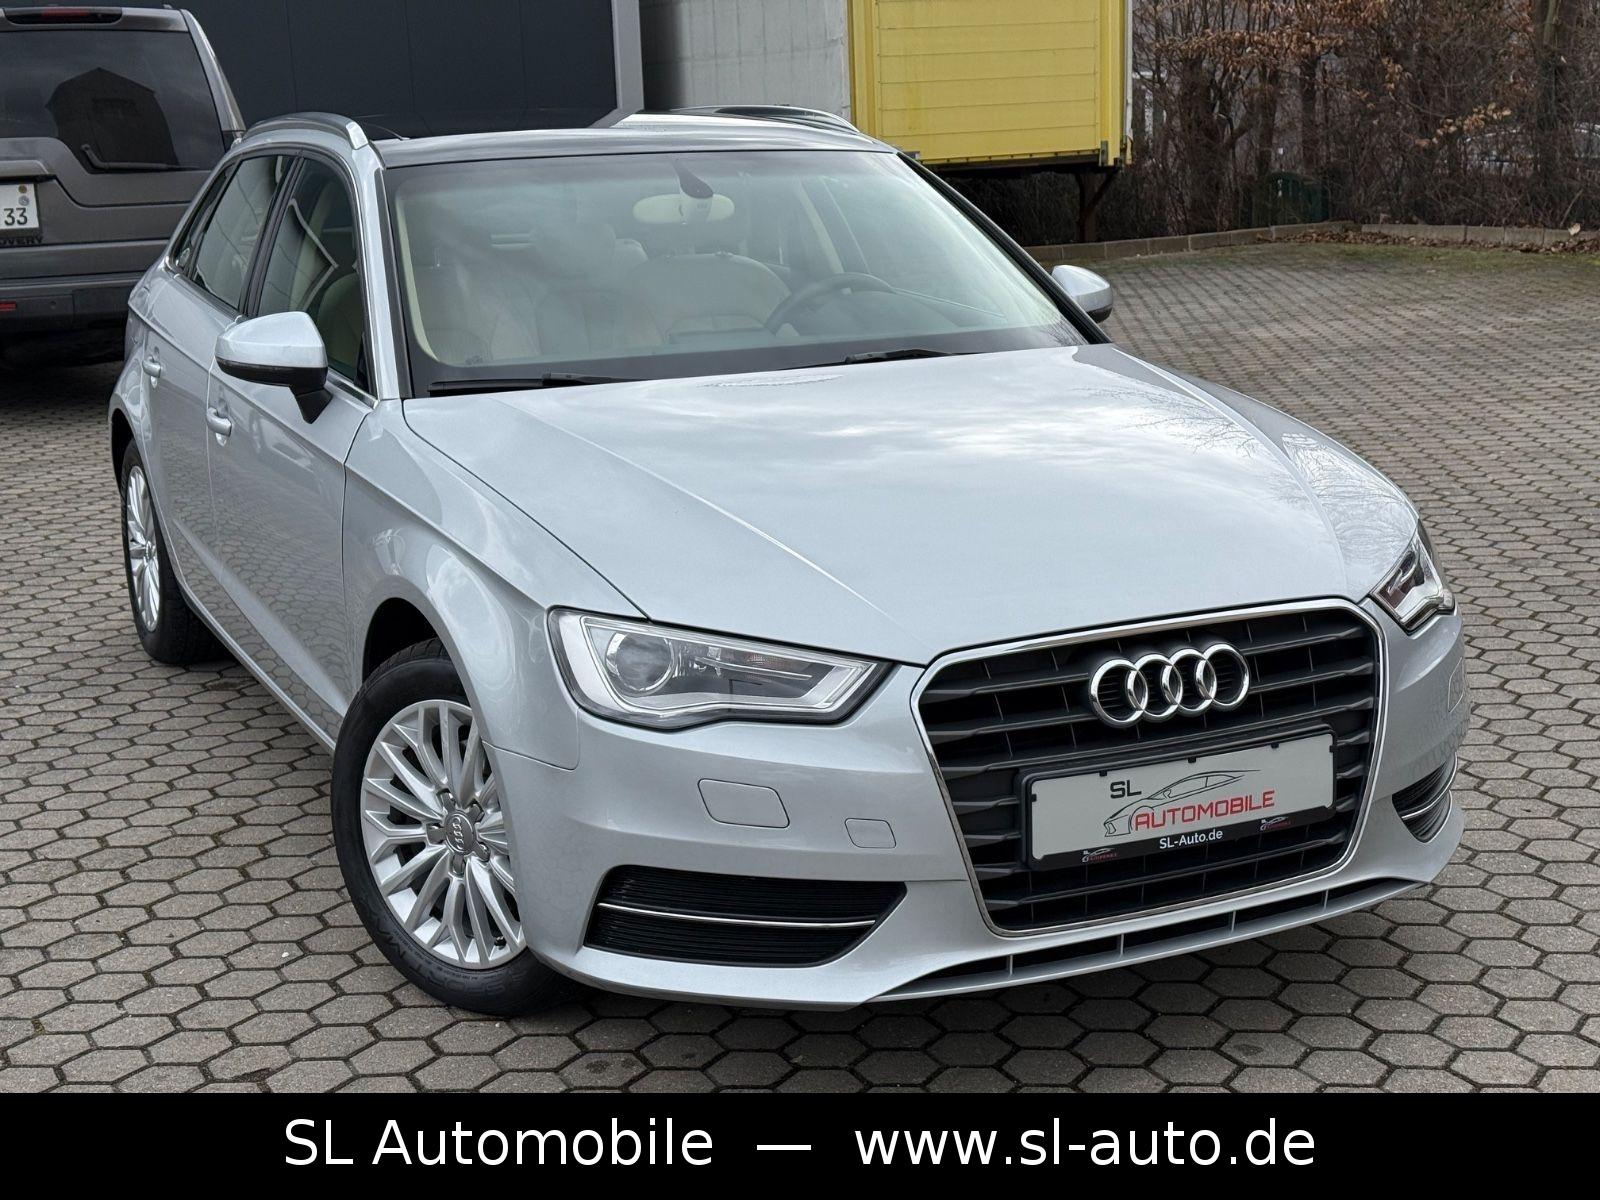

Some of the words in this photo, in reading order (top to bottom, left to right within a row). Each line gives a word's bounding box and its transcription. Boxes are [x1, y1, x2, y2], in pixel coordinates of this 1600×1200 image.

[4, 207, 28, 226] 33
[1110, 780, 1142, 799] SL
[1135, 790, 1275, 831] AUTOMOBILE
[1159, 829, 1224, 849] SL-Auto.de
